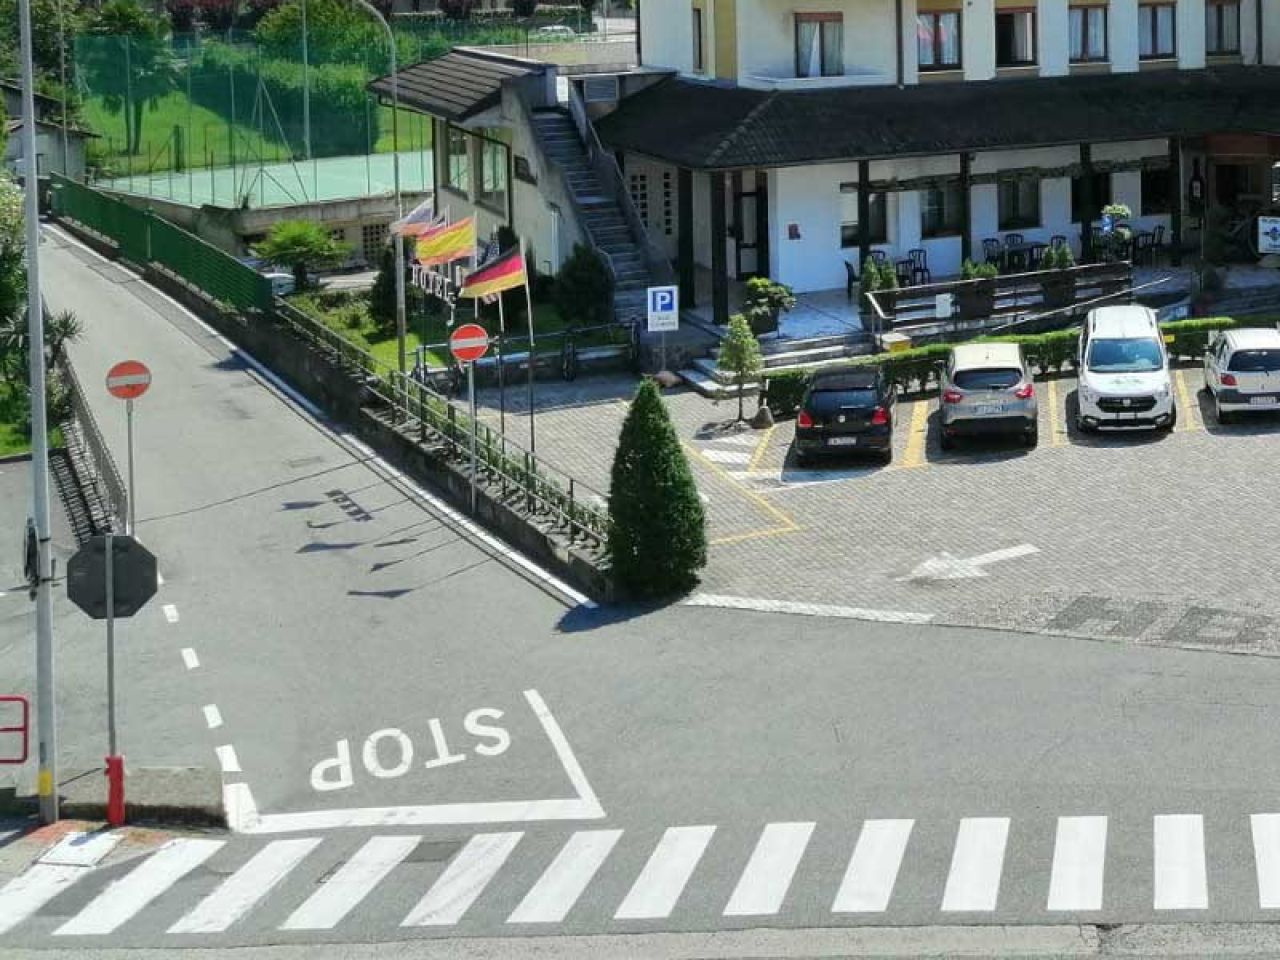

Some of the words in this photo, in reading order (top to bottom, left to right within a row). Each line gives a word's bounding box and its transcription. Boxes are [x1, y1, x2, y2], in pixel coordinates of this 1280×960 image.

[411, 264, 455, 302] HOTEL
[655, 292, 671, 312] P
[309, 707, 511, 791] STOP
